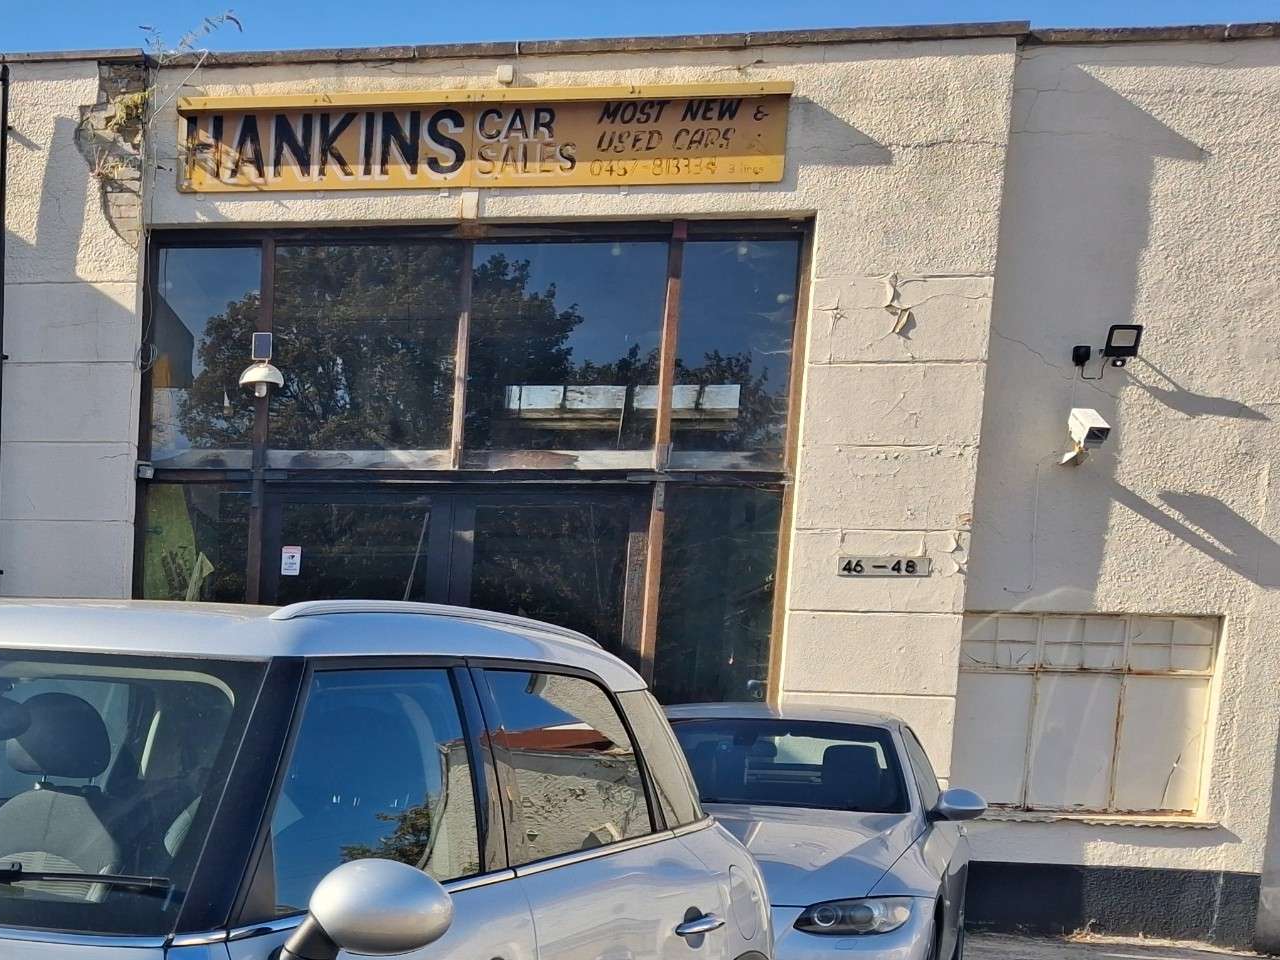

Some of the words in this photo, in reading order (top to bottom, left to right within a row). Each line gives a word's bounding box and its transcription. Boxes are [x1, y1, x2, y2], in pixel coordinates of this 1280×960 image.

[478, 107, 556, 139] CAR
[597, 101, 671, 125] MOST
[681, 98, 743, 122] NEW
[186, 108, 465, 179] HANKINS
[596, 129, 663, 153] USED
[672, 127, 736, 151] CARS
[478, 142, 577, 175] SALES
